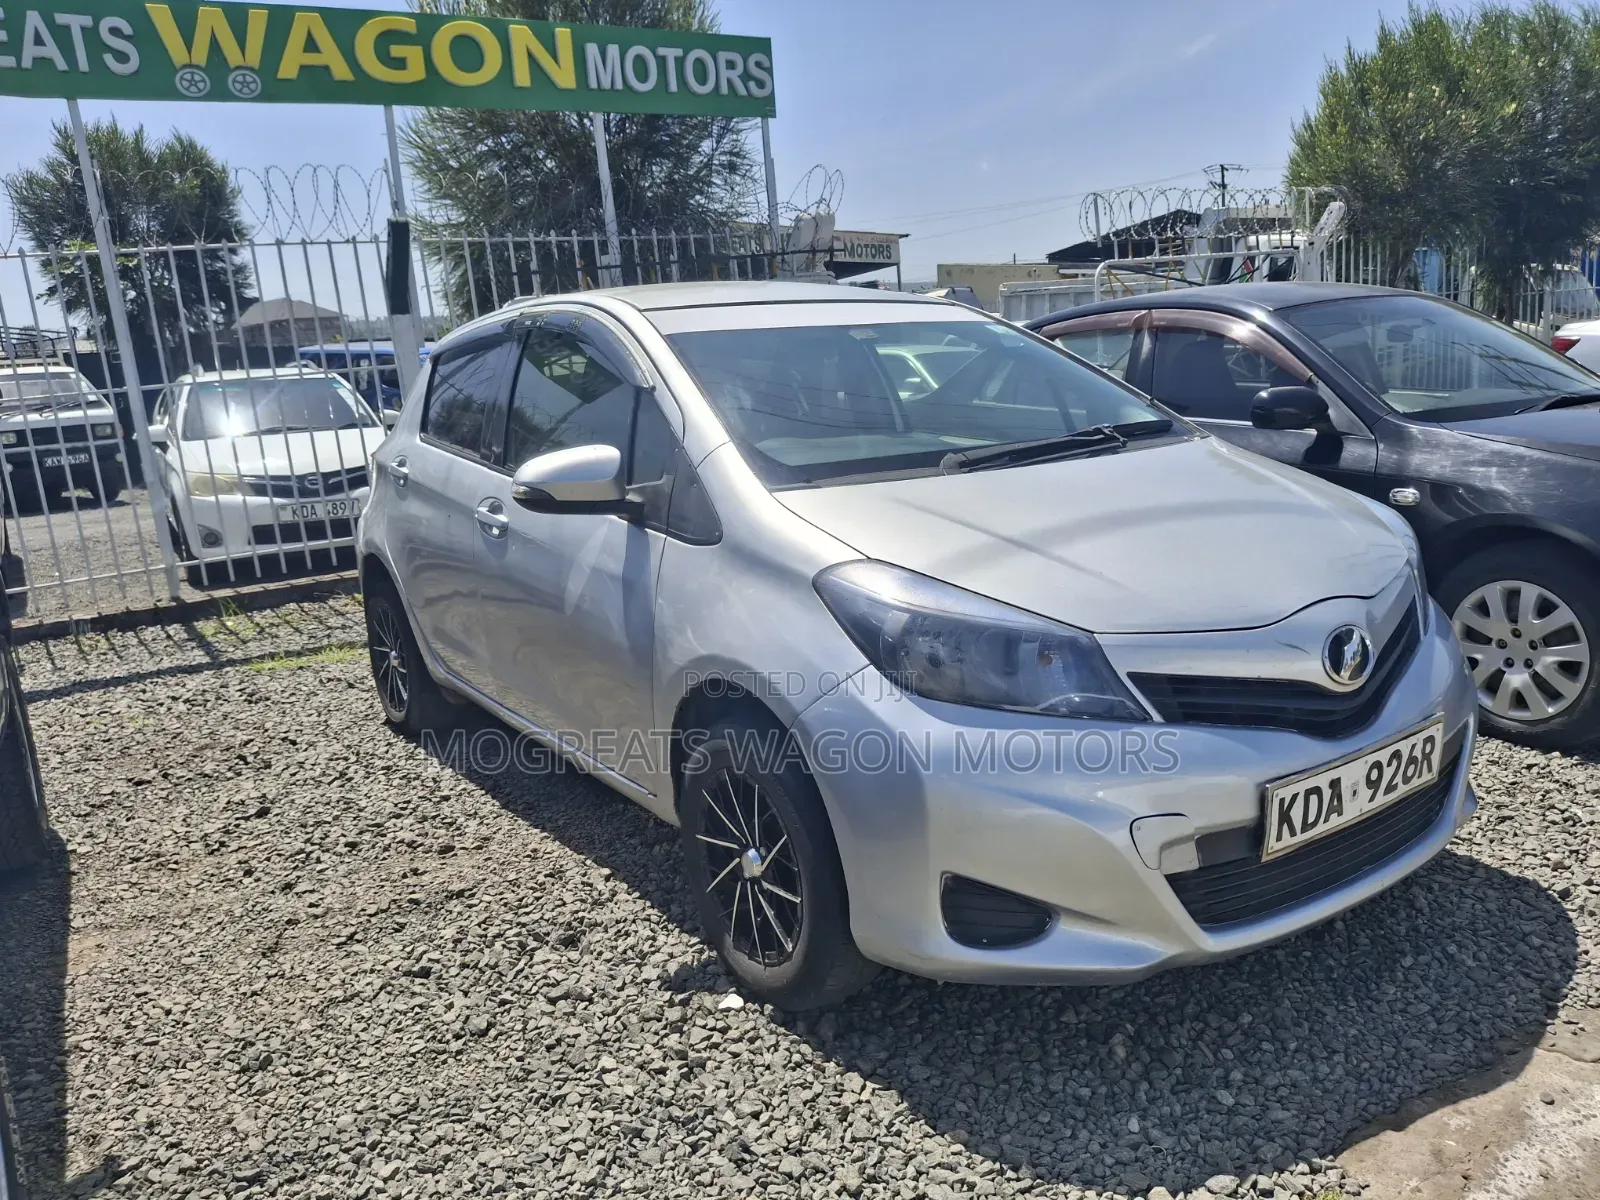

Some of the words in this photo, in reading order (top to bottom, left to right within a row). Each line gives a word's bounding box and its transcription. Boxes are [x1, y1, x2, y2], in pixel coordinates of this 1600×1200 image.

[145, 3, 577, 90] WAGON
[584, 42, 774, 98] MOTORS
[843, 241, 892, 260] MOTORS
[291, 504, 318, 520] KDA
[1275, 776, 1344, 842] KDA
[1365, 734, 1436, 804] 926R
